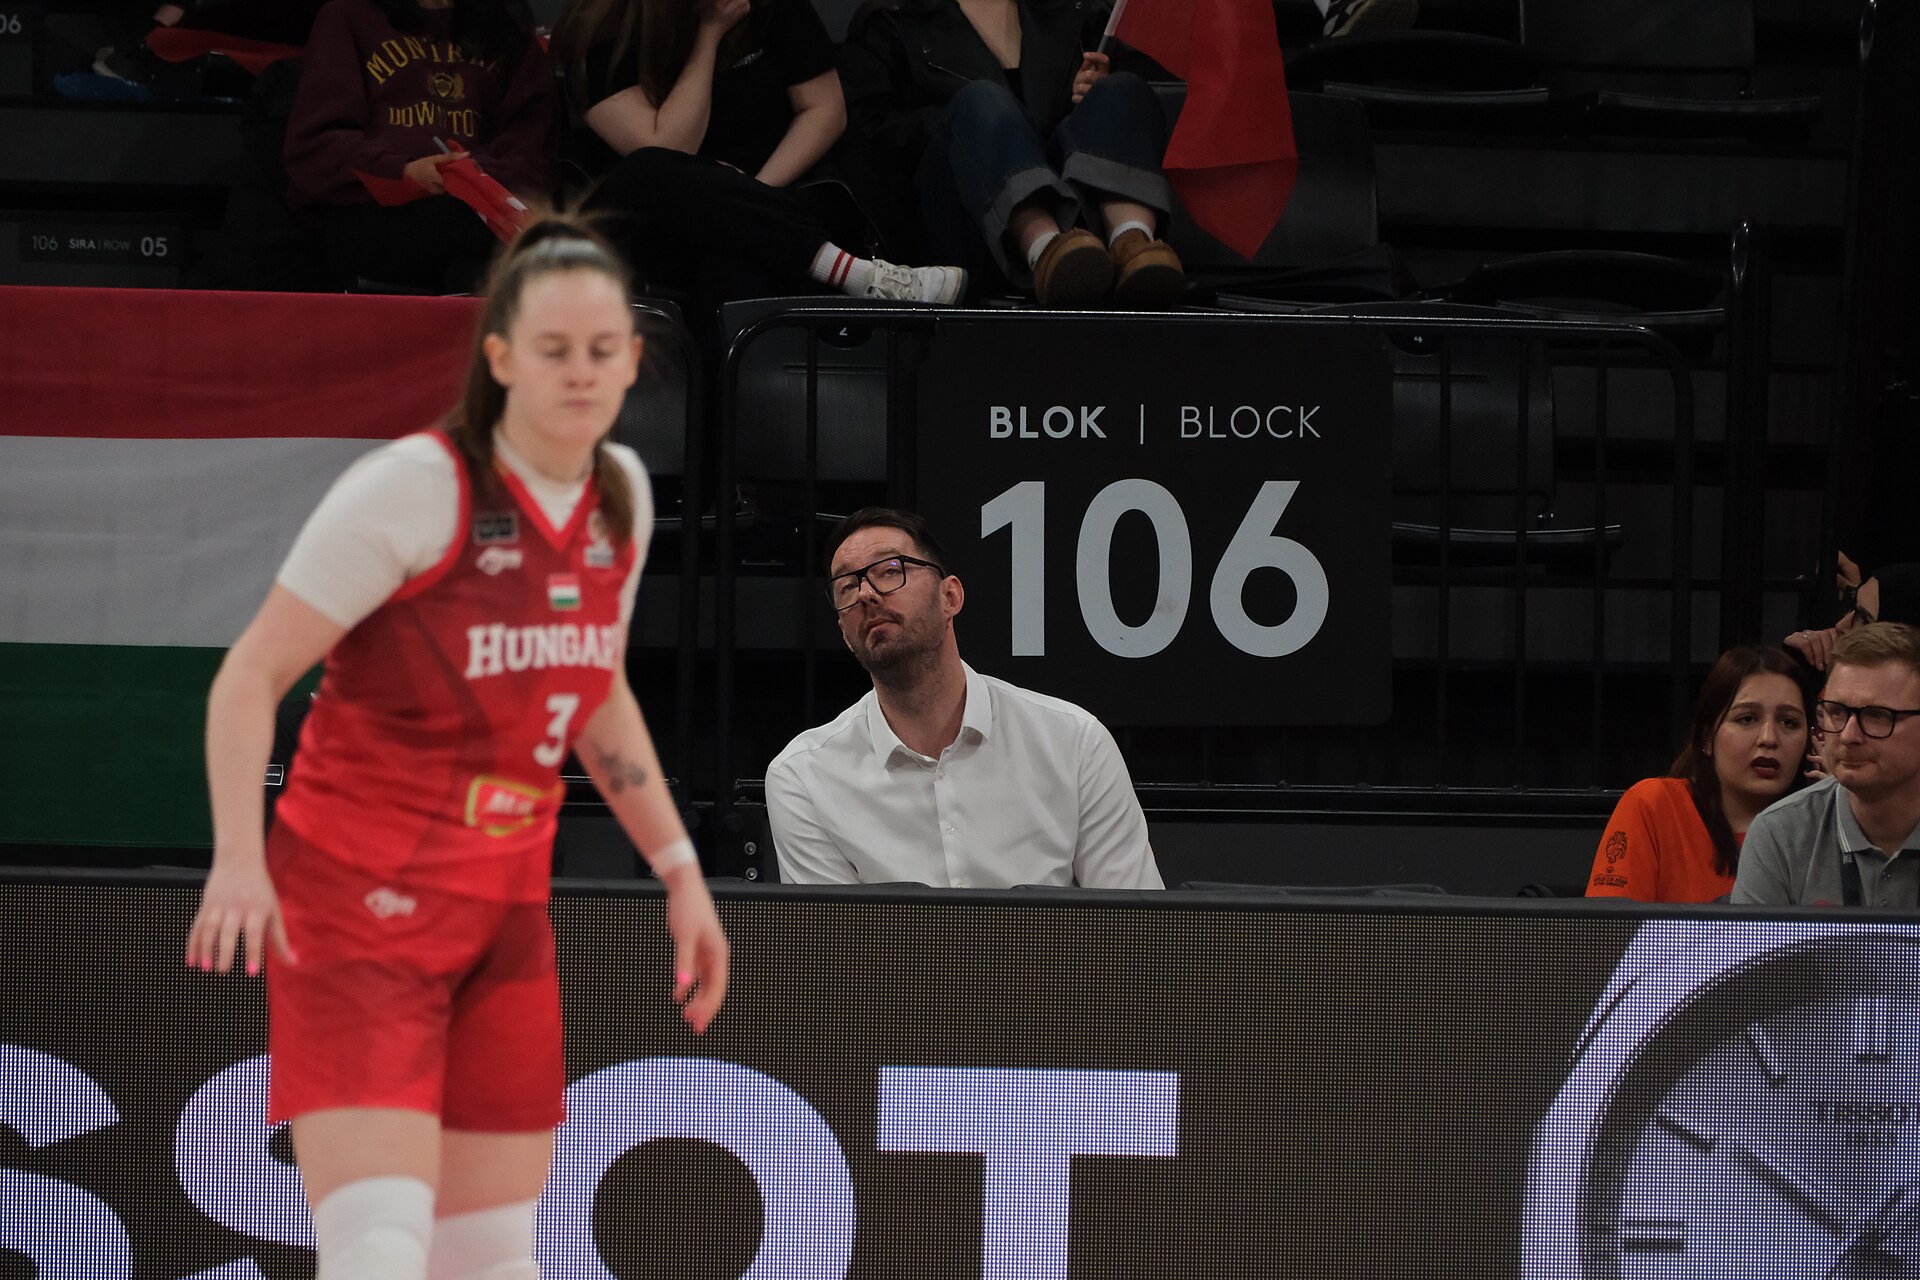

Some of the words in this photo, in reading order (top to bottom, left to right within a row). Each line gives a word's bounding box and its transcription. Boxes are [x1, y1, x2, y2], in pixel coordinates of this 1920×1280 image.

[366, 36, 497, 85] MONTR
[32, 235, 58, 251] 106
[68, 238, 96, 250] SIRA
[103, 239, 131, 250] ROW
[140, 236, 168, 257] 05
[990, 405, 1107, 439] BLOK
[1180, 405, 1321, 439] BLOCK
[981, 478, 1330, 658] 106
[532, 693, 581, 768] 3
